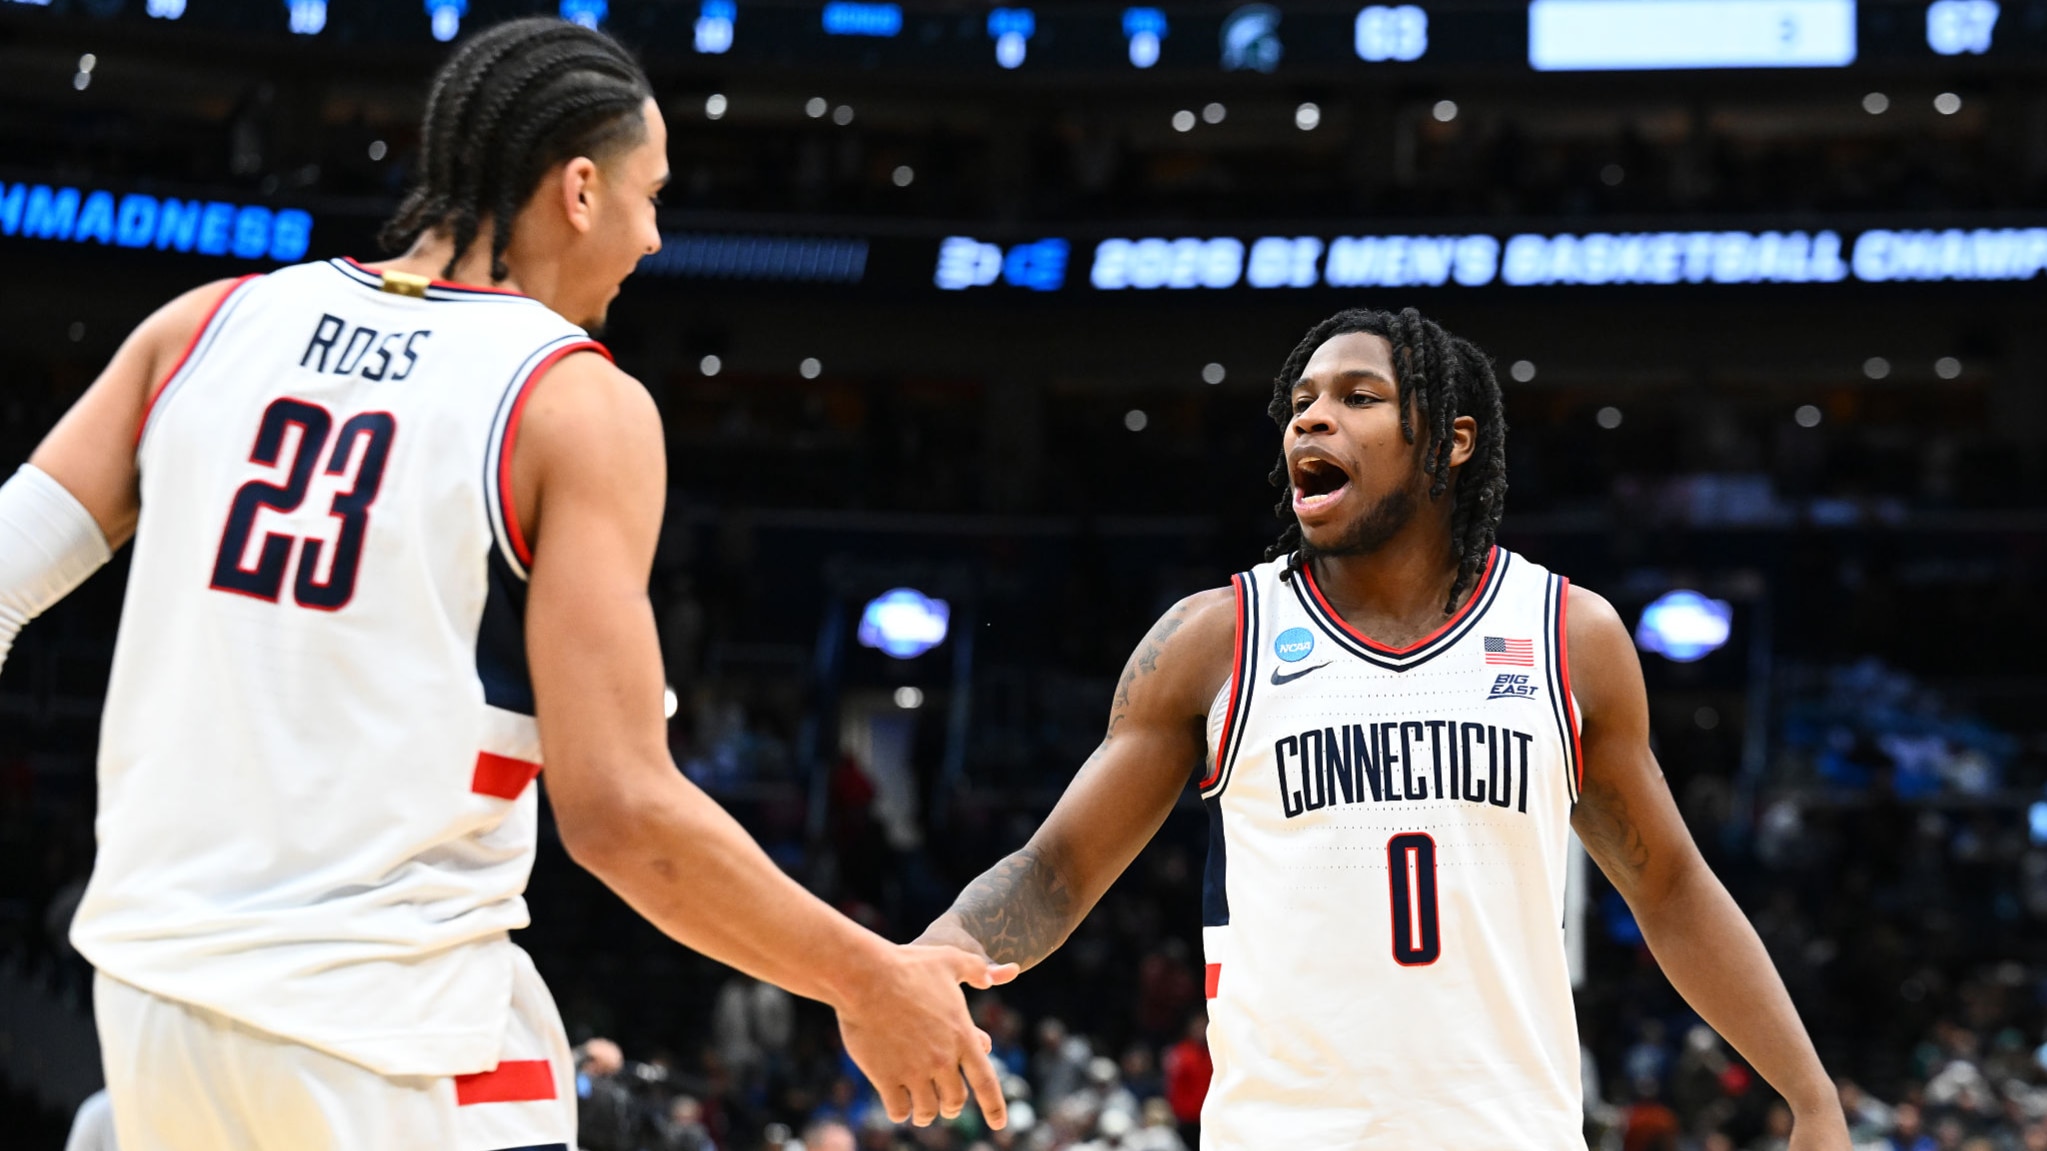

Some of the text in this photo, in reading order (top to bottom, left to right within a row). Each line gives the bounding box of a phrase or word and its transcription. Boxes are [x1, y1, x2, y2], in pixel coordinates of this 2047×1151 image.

[1502, 231, 1849, 286] BASKETBALL
[300, 313, 432, 382] ROSS
[208, 396, 397, 612] 23
[1280, 641, 1311, 653] NCAA
[1490, 684, 1539, 695] EAST
[1494, 673, 1530, 684] BIG
[1275, 720, 1533, 818] CONNECTICUT
[1387, 832, 1441, 967] 0
